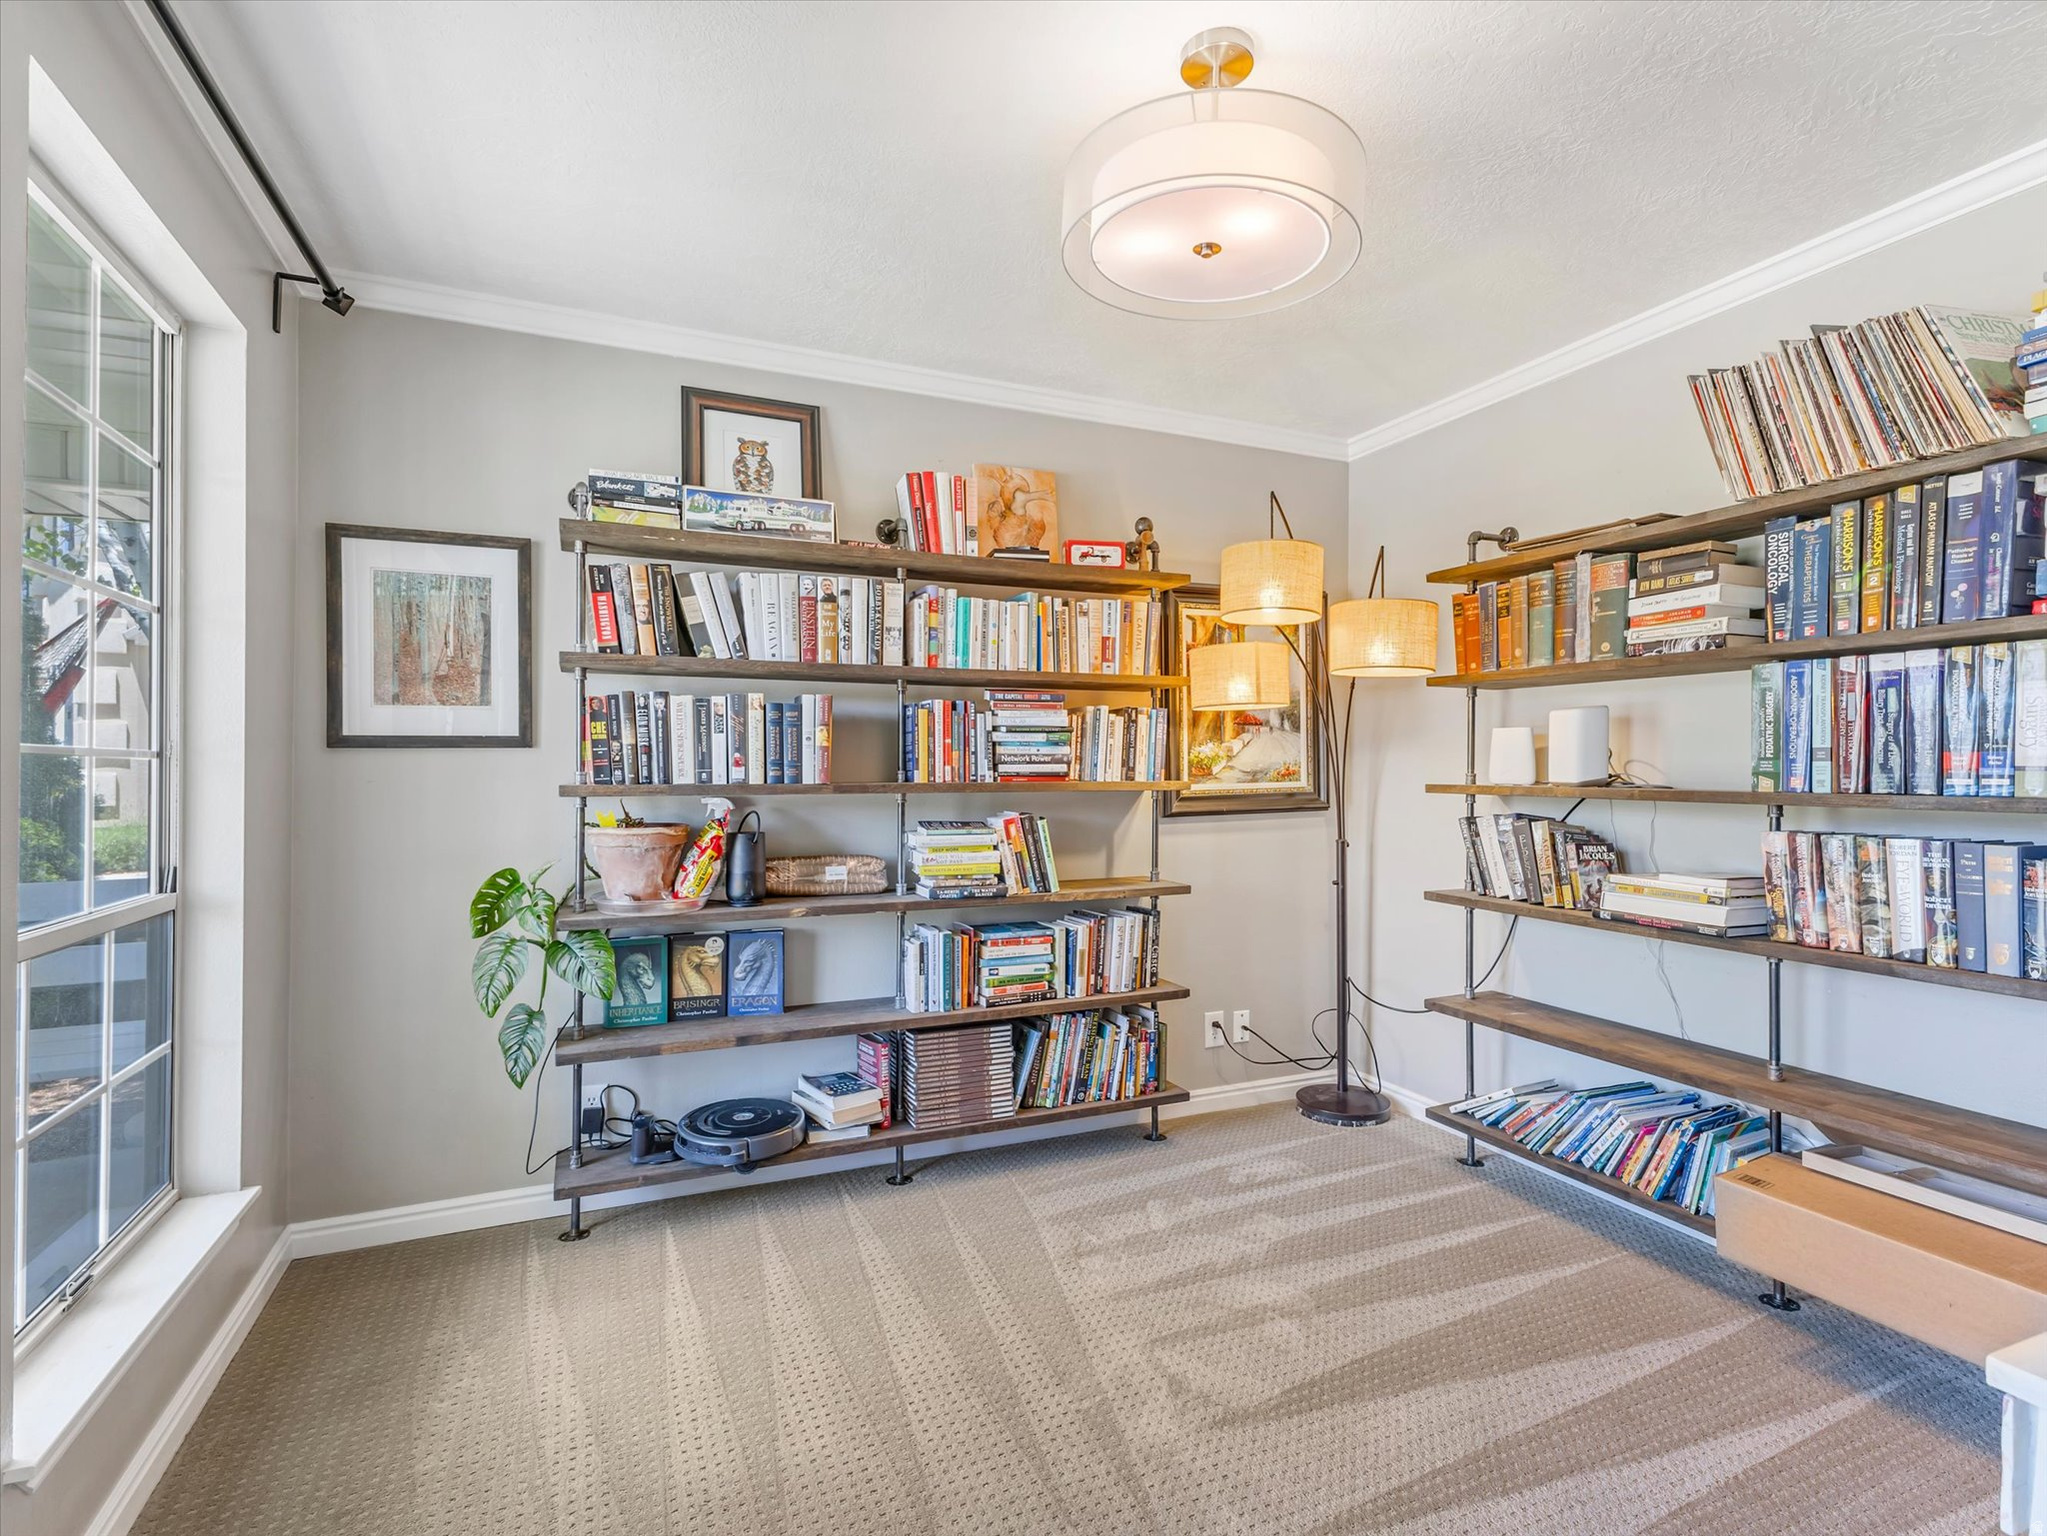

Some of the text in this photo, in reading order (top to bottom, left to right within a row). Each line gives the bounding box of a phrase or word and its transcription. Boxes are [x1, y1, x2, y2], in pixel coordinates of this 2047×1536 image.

[2023, 350, 2047, 363] PLAG
[596, 480, 635, 492] Blankets
[1843, 513, 1854, 572] HARRISON'S
[1873, 506, 1884, 566] HARRISON'S
[1925, 502, 1936, 587] ATLAS OF HUMAN ANATOMY
[1768, 534, 1778, 595] ONCOLOGY
[1778, 532, 1789, 587] SURGICAL
[1803, 546, 1813, 604] THERAPEUTICS
[1894, 525, 1906, 595] Medical Physiology
[1639, 578, 1664, 592] AYN RAND
[1840, 582, 1847, 590] 1
[1870, 576, 1877, 585] 2
[596, 595, 613, 640] WASHINGTON
[664, 596, 673, 632] SNOWBALL
[766, 602, 778, 651] REAGAN
[806, 600, 815, 650] EINSTEIN
[821, 619, 835, 628] My
[820, 630, 836, 638] Life
[874, 613, 882, 651] KENNEDY
[698, 707, 707, 725] JAMES
[1876, 689, 1885, 709] Biliary
[637, 709, 650, 746] ELON MUSK
[730, 713, 744, 748] Jefferson
[1765, 691, 1774, 758] PEDIATRIC SURGERY
[1789, 716, 1797, 759] OPERATIONS
[1886, 713, 1895, 735] Surgery
[2019, 696, 2040, 750] Surgery
[1001, 754, 1052, 762] Network Power
[1847, 722, 1855, 762] TEXTBOOK
[1543, 846, 1551, 870] CLASH
[1578, 849, 1616, 861] JACQUES
[1582, 845, 1608, 853] BRIAN
[1896, 860, 1913, 943] EYE WORLD
[1151, 945, 1159, 973] Caste
[609, 1006, 663, 1017] INHERITANCE
[673, 998, 721, 1011] BRISINGR
[731, 996, 778, 1008] ERAGON
[1089, 1012, 1098, 1046] DRESSING
